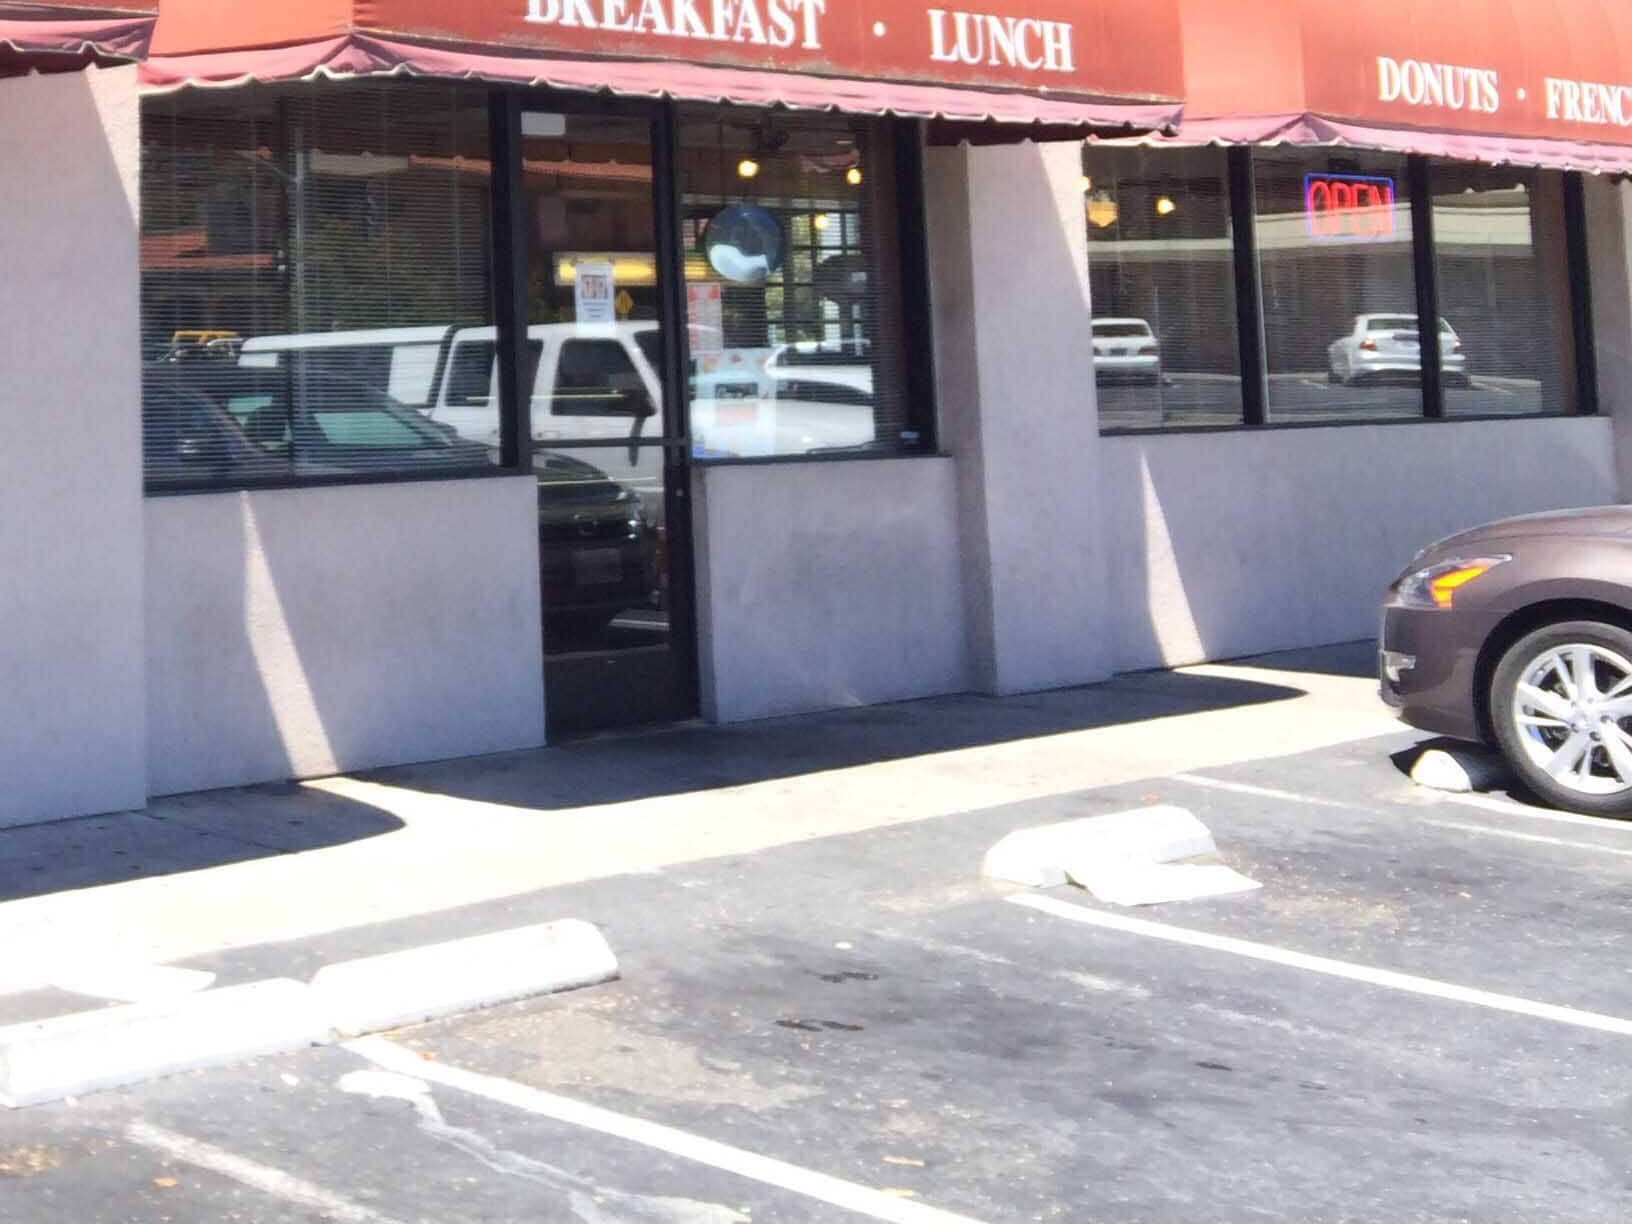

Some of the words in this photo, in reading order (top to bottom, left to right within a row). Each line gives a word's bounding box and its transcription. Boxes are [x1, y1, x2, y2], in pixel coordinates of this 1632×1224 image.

[928, 9, 1076, 73] LUNCH
[1376, 56, 1499, 113] DONUTS
[1308, 180, 1394, 237] OPEN
